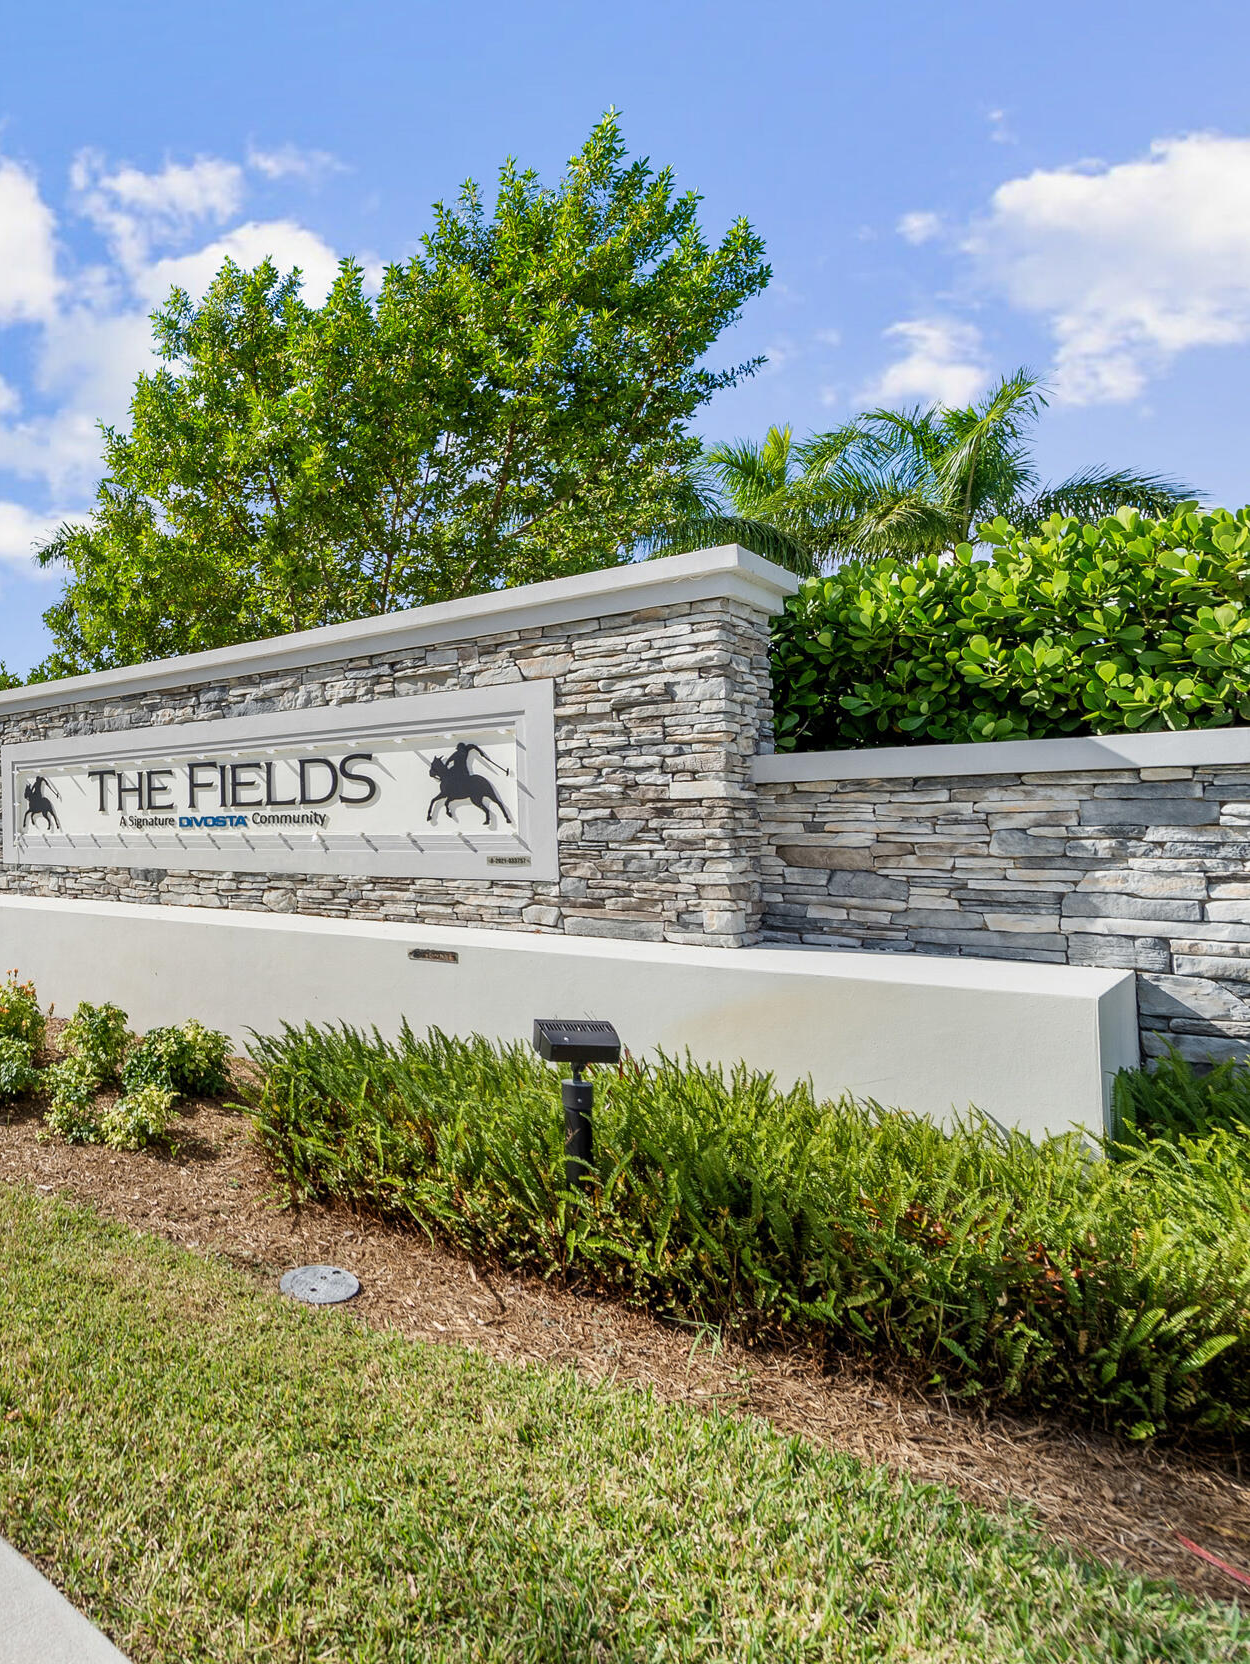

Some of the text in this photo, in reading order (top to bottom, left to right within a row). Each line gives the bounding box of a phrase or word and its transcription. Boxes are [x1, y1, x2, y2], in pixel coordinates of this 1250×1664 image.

[88, 753, 377, 812] THE FIELDS
[119, 816, 127, 827] A
[128, 815, 175, 829] Signature
[251, 811, 327, 827] Community
